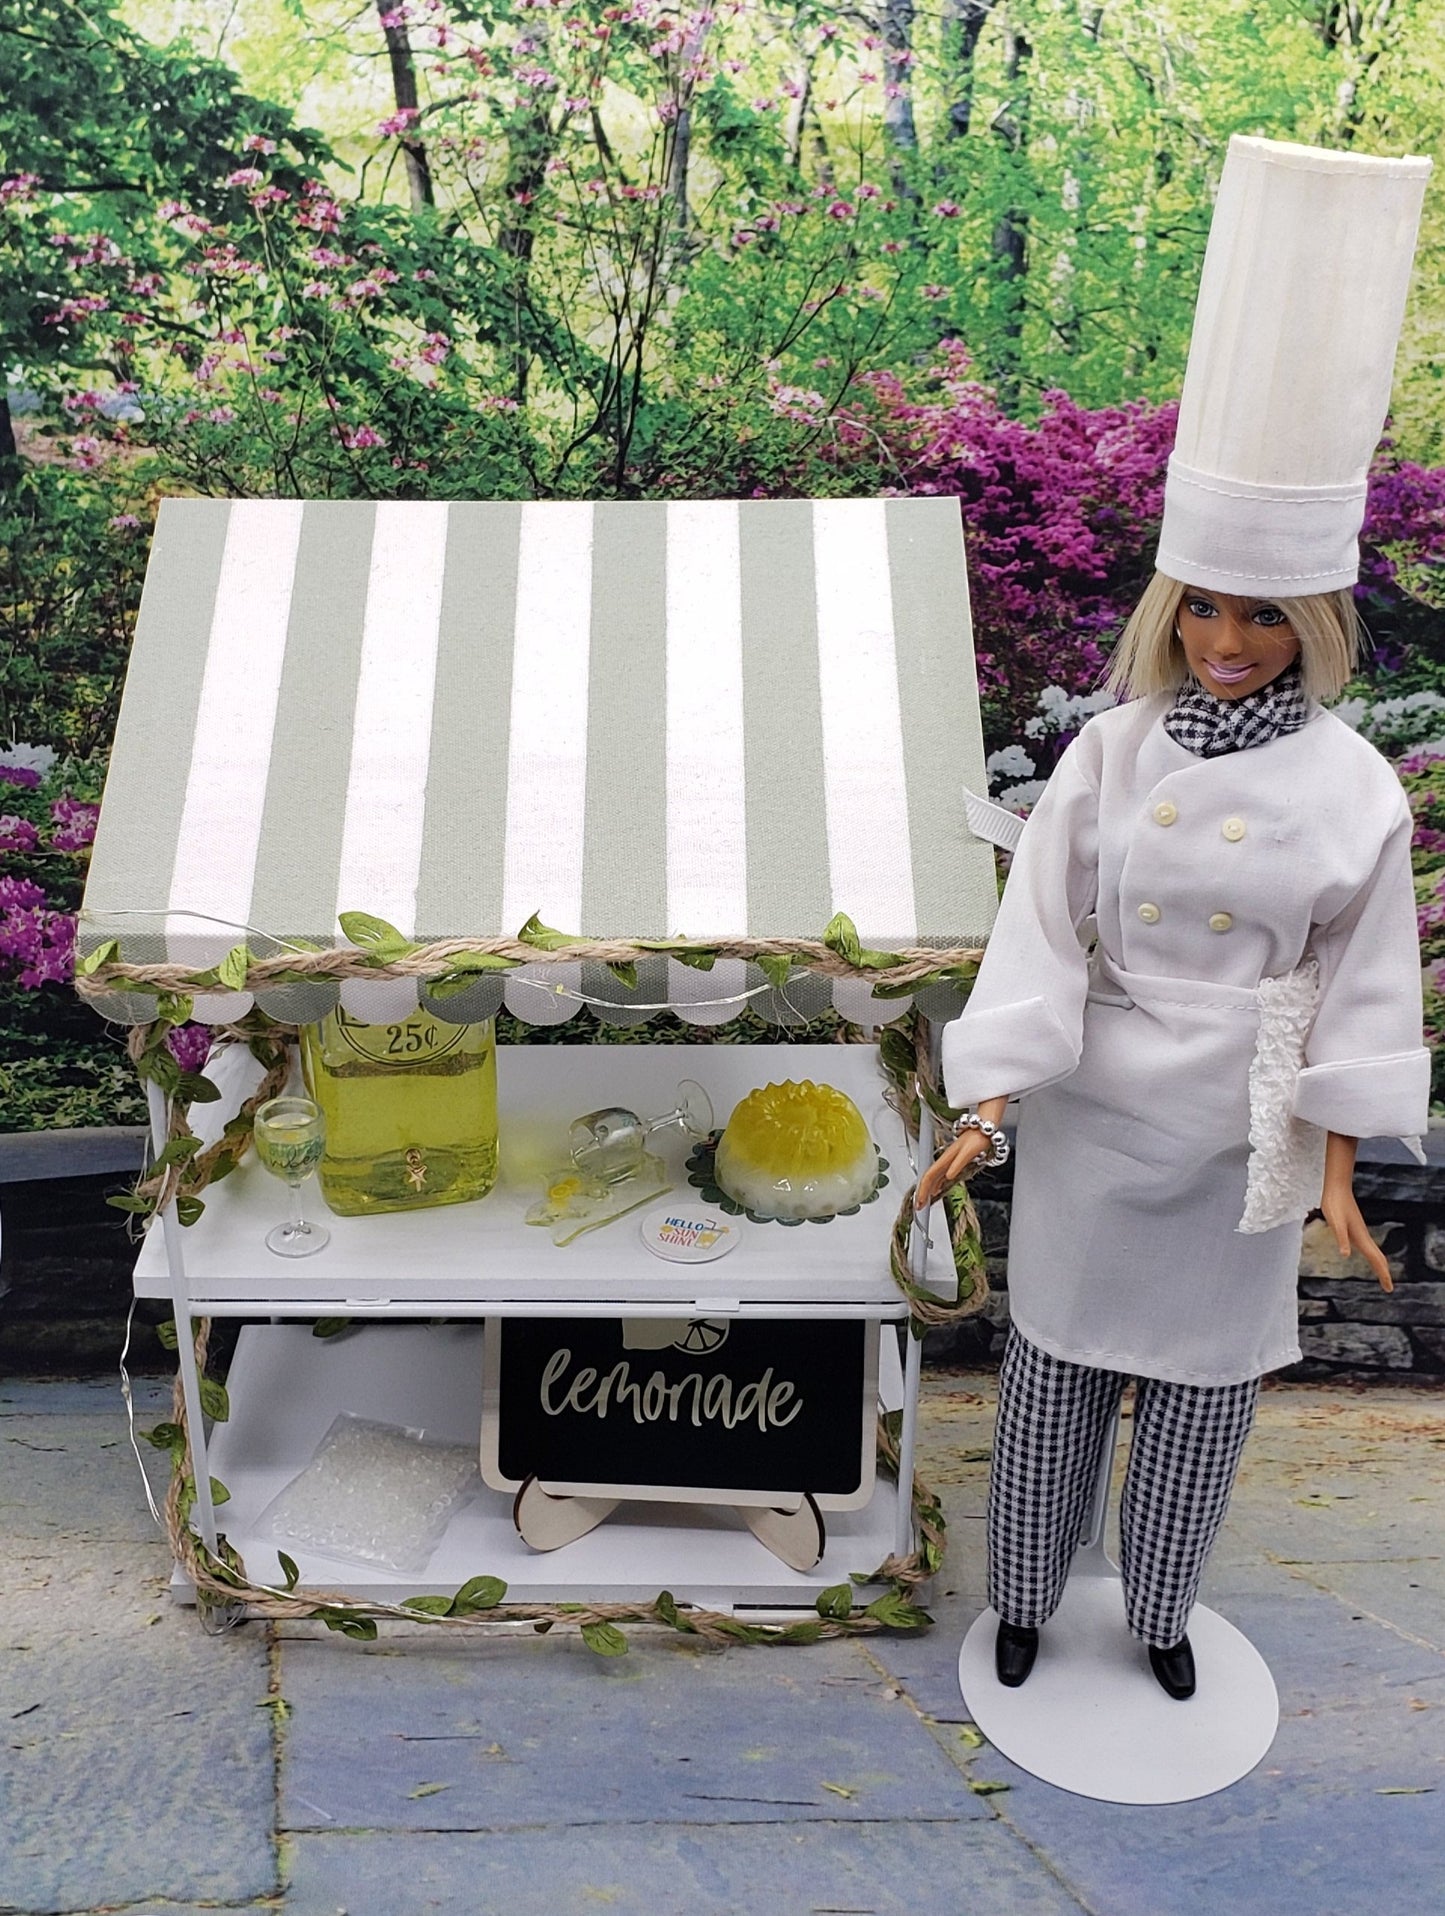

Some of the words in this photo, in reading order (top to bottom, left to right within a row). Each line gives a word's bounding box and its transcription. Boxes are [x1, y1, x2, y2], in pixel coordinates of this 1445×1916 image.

[386, 1023, 439, 1054] 25¢
[664, 1216, 704, 1231] HELLO
[673, 1227, 699, 1240] SUN
[540, 1348, 804, 1432] lemonade
